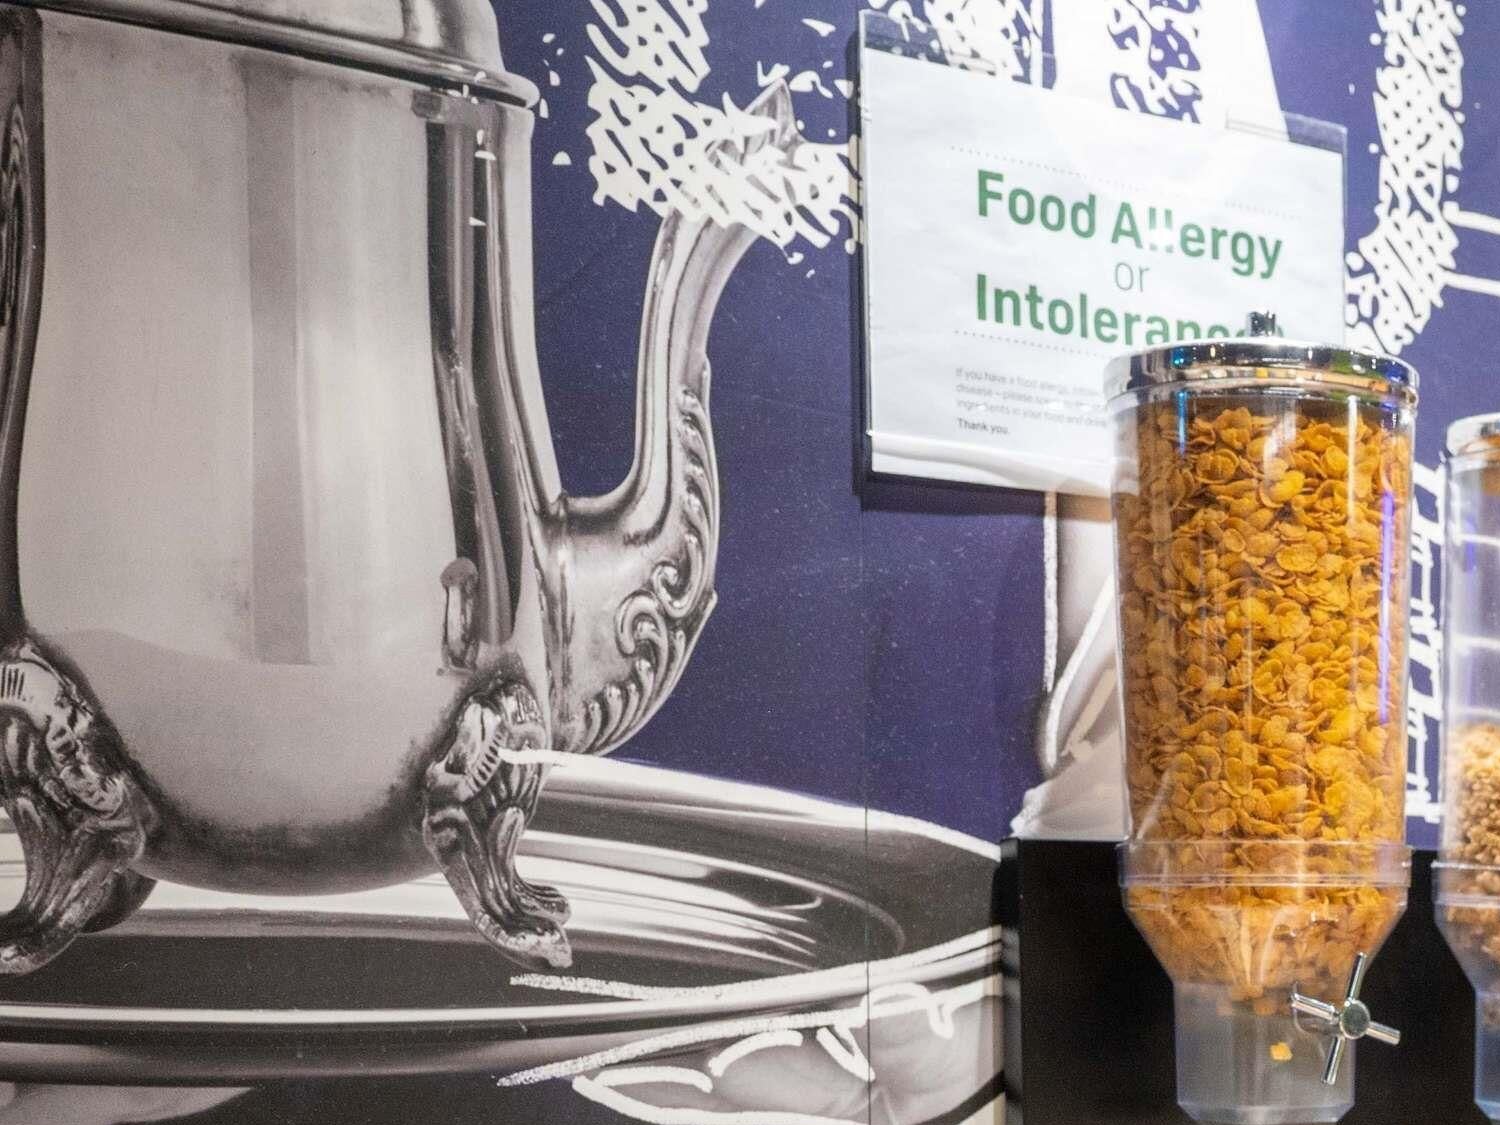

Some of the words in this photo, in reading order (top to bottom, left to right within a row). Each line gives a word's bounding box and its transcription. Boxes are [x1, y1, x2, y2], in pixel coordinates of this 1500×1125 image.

[976, 169, 1096, 239] Food
[1111, 200, 1283, 280] Allergy
[1114, 261, 1151, 293] or
[956, 416, 988, 433] Thank
